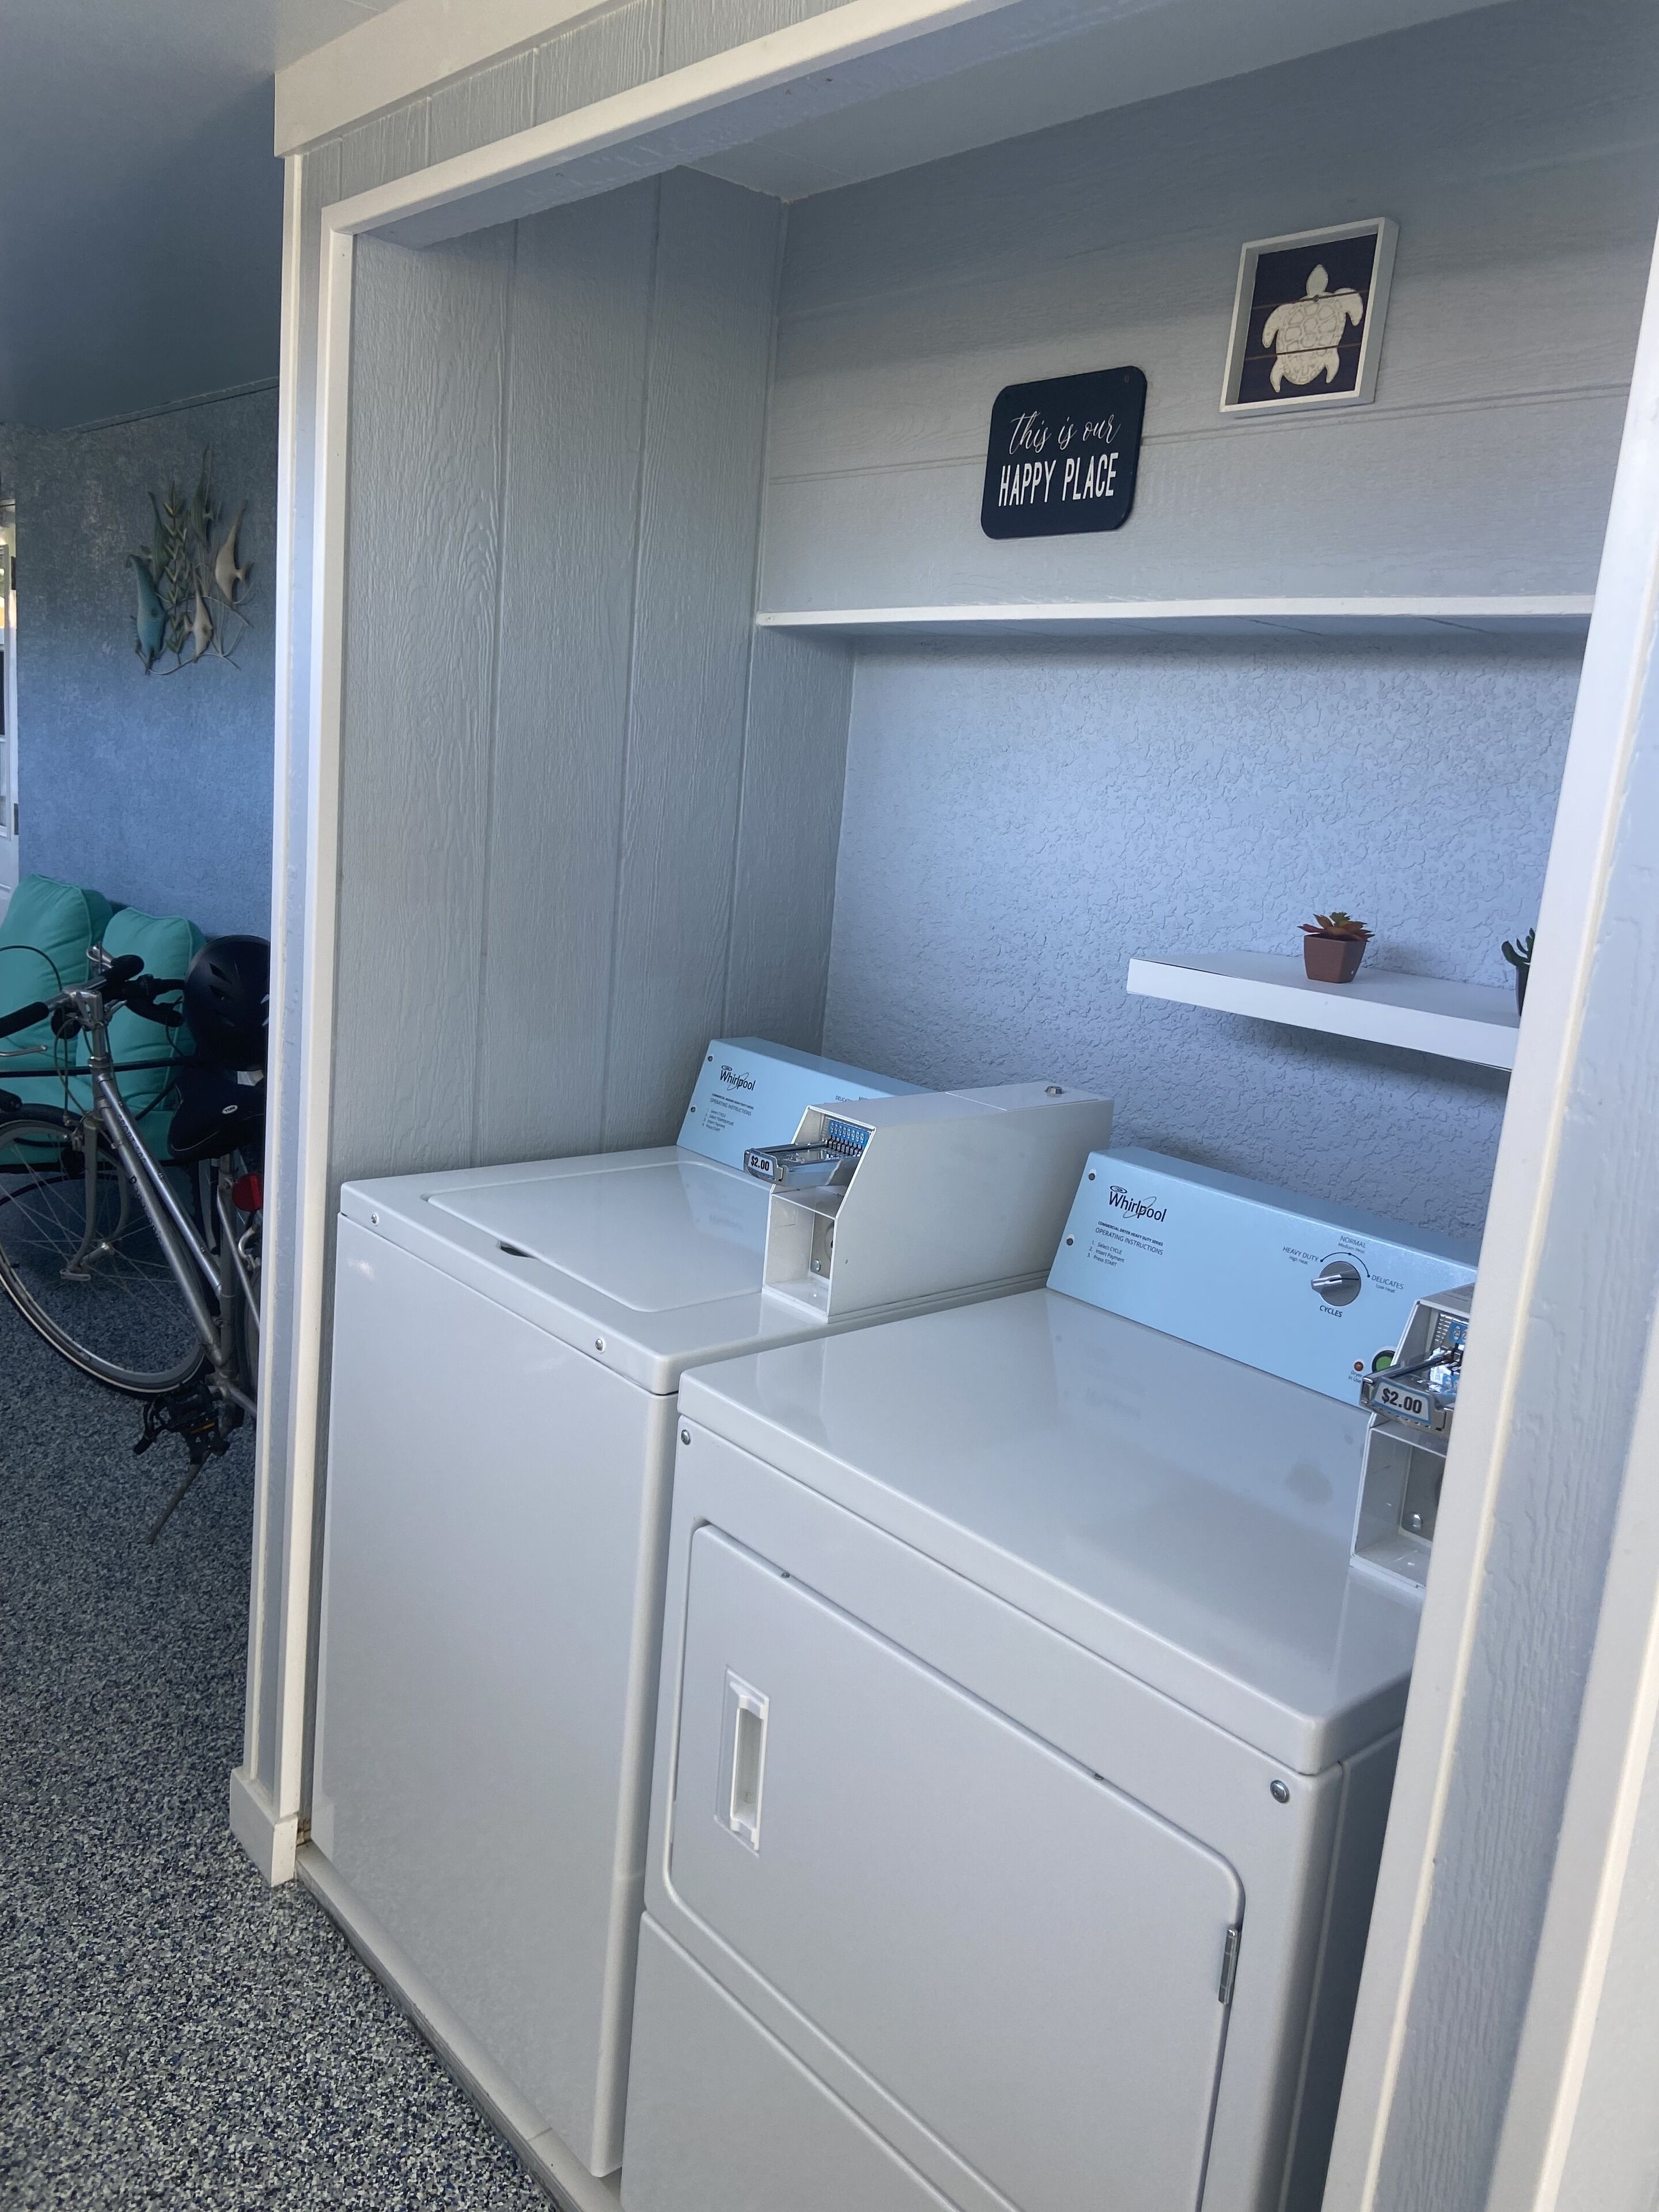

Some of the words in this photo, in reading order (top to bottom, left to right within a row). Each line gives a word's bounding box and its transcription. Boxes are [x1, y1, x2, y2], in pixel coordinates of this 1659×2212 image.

[1058, 416, 1077, 450] is
[1082, 414, 1121, 444] our
[998, 460, 1056, 507] HAPPY
[1062, 452, 1119, 501] PLACE
[720, 1070, 756, 1091] Whirlpool
[710, 1098, 728, 1108] OPERATING
[728, 1104, 752, 1116] INSTRUCTIONS
[751, 1154, 770, 1171] $2.00
[1109, 1191, 1167, 1222] Whirlpool
[1098, 1221, 1119, 1232] COMMERCIAL
[1095, 1228, 1124, 1242] OPERATING
[1124, 1237, 1164, 1255] INSTRUCTIONS
[1338, 1242, 1354, 1251] Medium
[1340, 1236, 1367, 1248] NORMAL
[1107, 1252, 1125, 1263] Payment
[1109, 1247, 1123, 1255] CYCLE
[1282, 1246, 1302, 1257] HEAVY
[1302, 1252, 1319, 1262] DUTY
[1093, 1255, 1104, 1263] Press
[1289, 1256, 1298, 1264] High
[1372, 1275, 1404, 1290] DELICATES
[1319, 1305, 1343, 1317] CYCLES
[1381, 1388, 1422, 1414] $2.00
